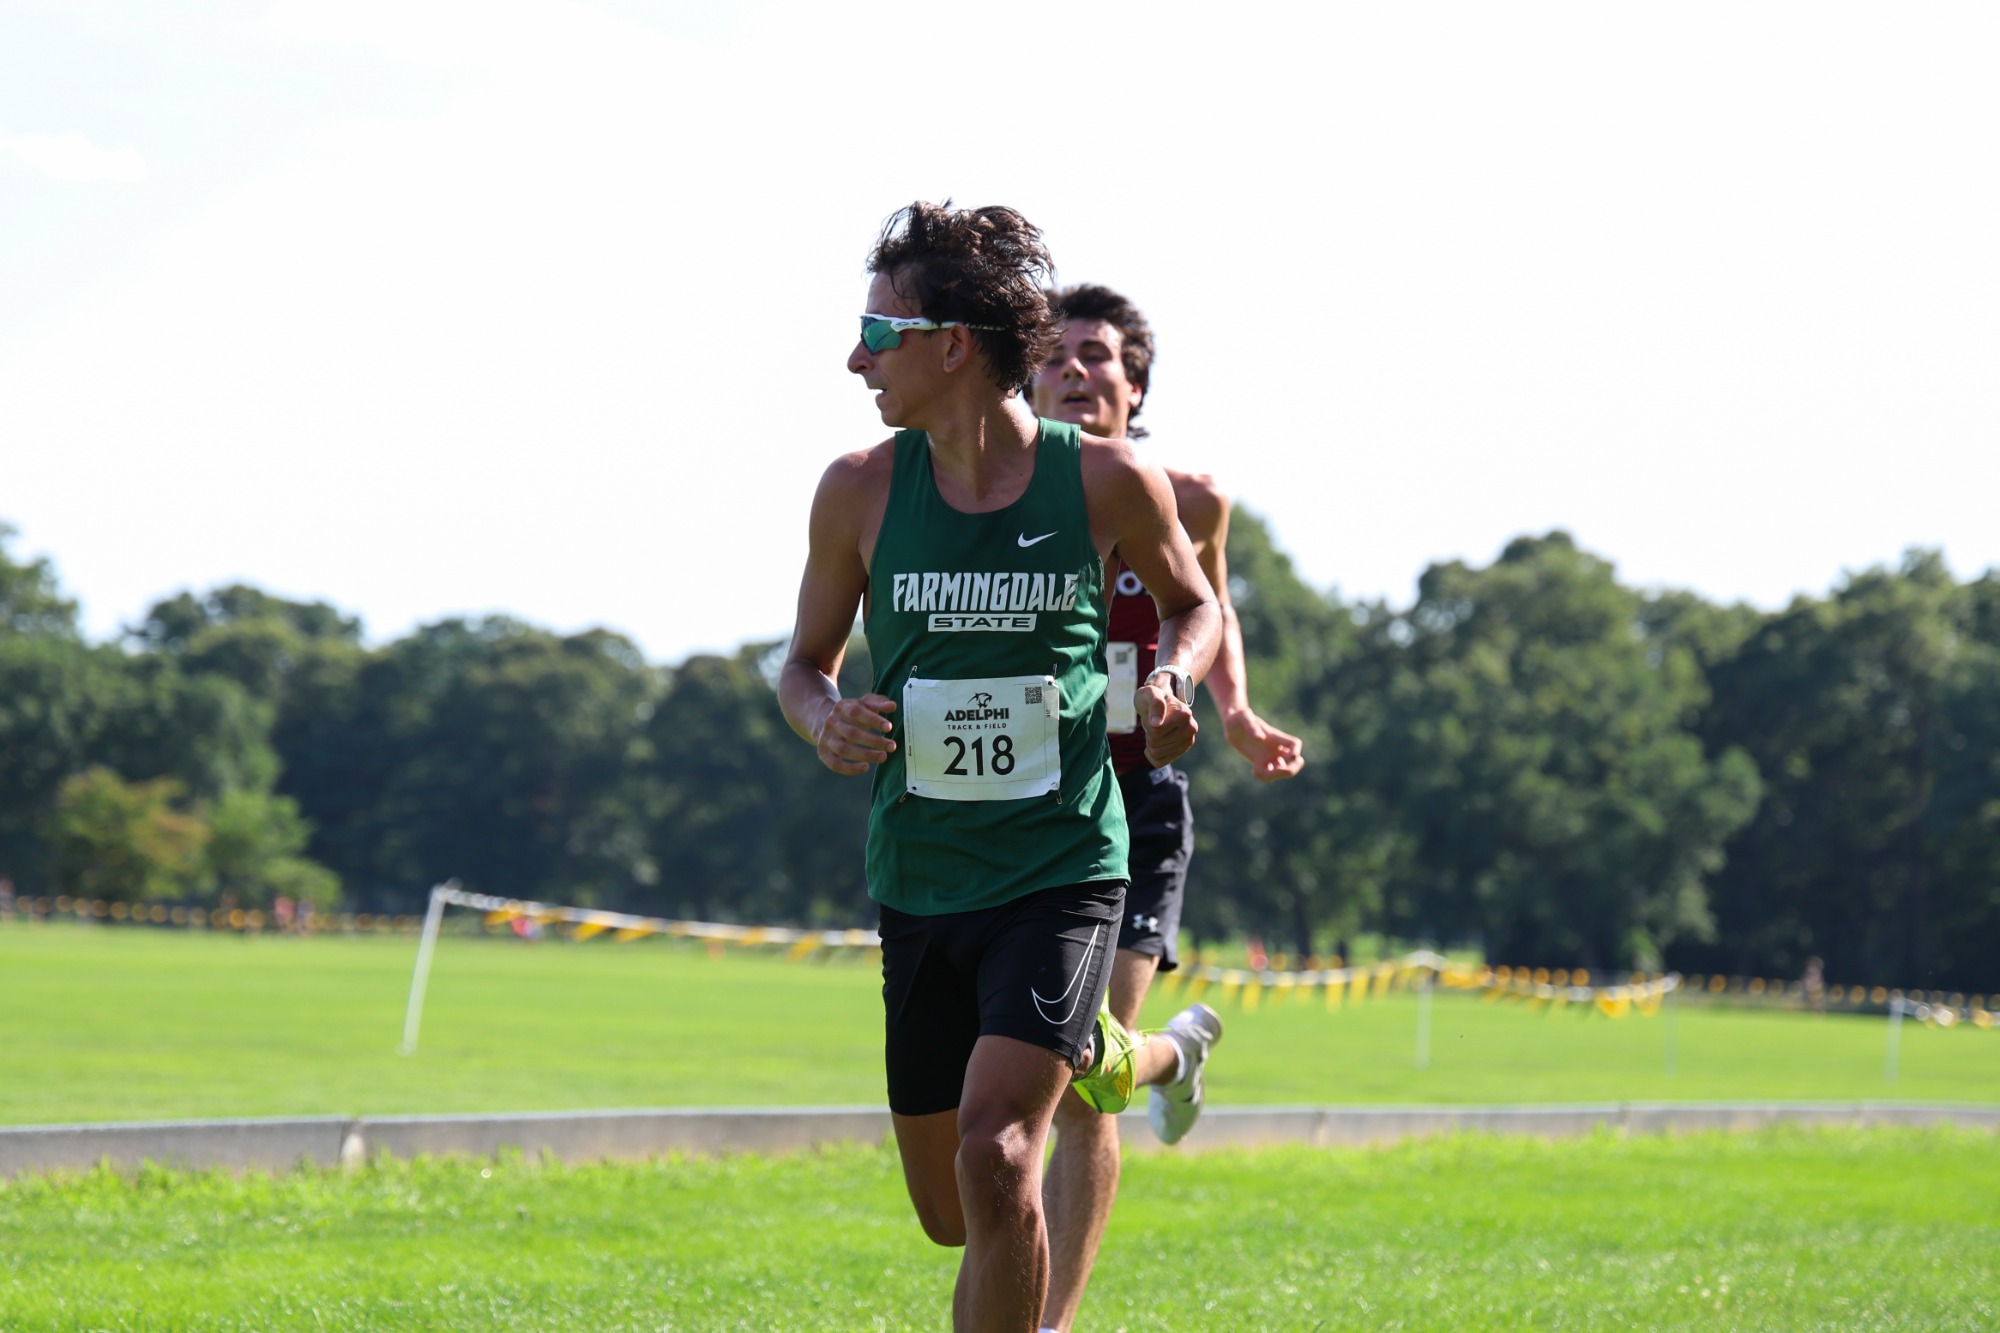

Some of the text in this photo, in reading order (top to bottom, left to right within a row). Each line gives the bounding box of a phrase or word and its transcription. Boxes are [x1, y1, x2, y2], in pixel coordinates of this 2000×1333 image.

[893, 572, 1079, 612] FARMINGDALE
[933, 617, 1031, 628] STATE
[944, 708, 1010, 722] ADELPHI
[943, 734, 1015, 776] 218
